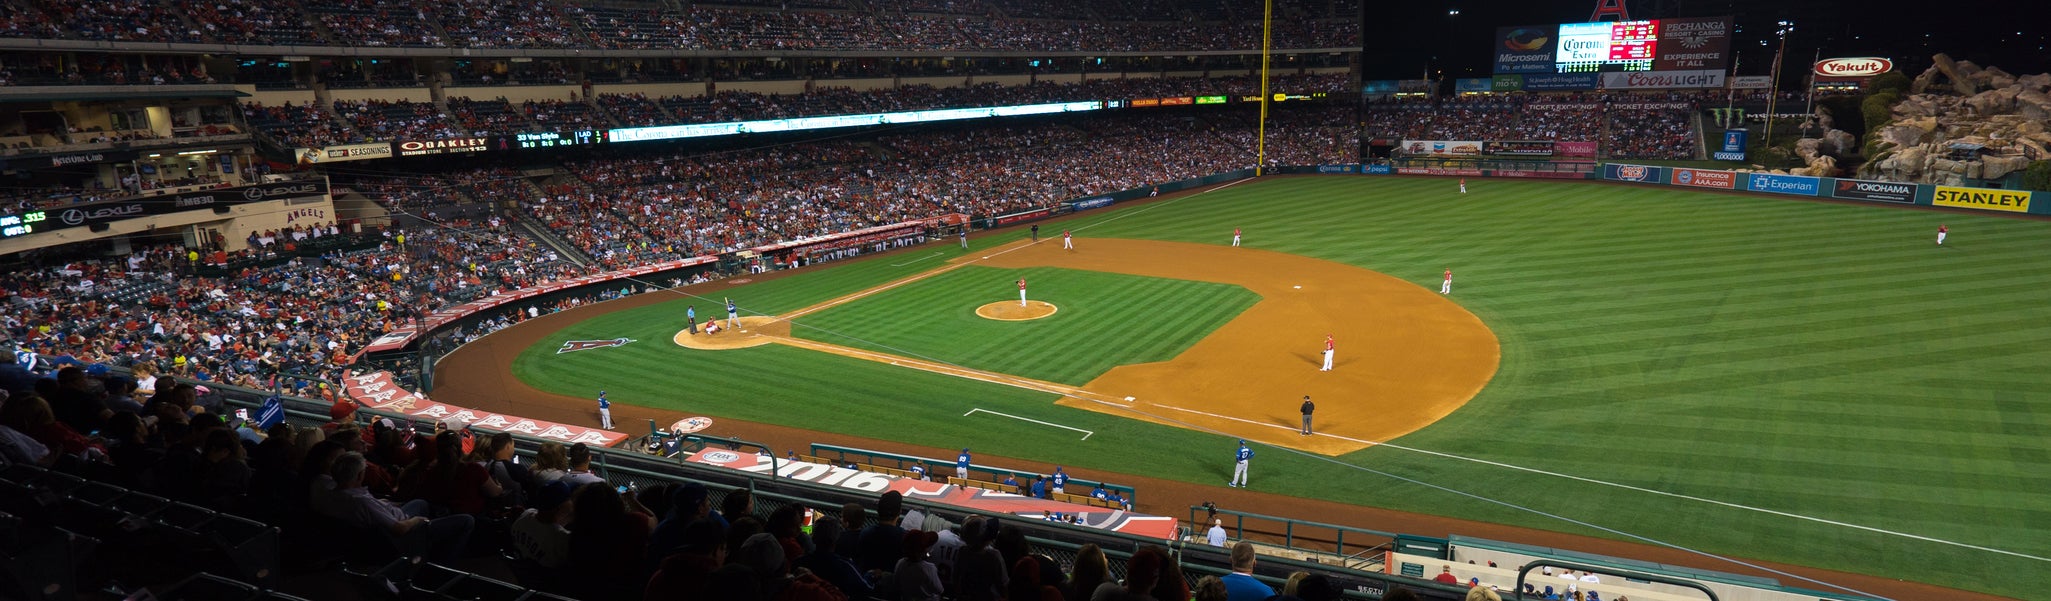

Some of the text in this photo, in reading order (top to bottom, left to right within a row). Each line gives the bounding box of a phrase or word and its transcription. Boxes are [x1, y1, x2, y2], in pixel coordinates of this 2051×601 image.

[1666, 21, 1726, 31] PECHANGA
[1563, 39, 1606, 53] Corona
[1499, 52, 1551, 63] Microsemi
[1572, 51, 1597, 59] Extra
[1664, 53, 1720, 61] EXPERIENCE
[1828, 62, 1881, 72] Yakult
[1628, 71, 1717, 87] Coors LIGHT
[527, 133, 541, 141] Van
[615, 129, 633, 141] The
[635, 128, 668, 140] Corona
[426, 138, 487, 150] OAKLEY
[350, 145, 390, 157] SEASONINGS
[1696, 170, 1730, 179] Insurance
[1694, 179, 1728, 187] AAA.com
[1771, 179, 1812, 191] Experian
[1856, 183, 1909, 194] YOKOHAMA
[263, 184, 317, 196] LEXUS
[1936, 190, 2028, 207] STANLEY
[24, 211, 46, 223] .315
[84, 204, 144, 219] LEXUS
[287, 208, 325, 224] ANGELS
[737, 454, 892, 494] 2016
